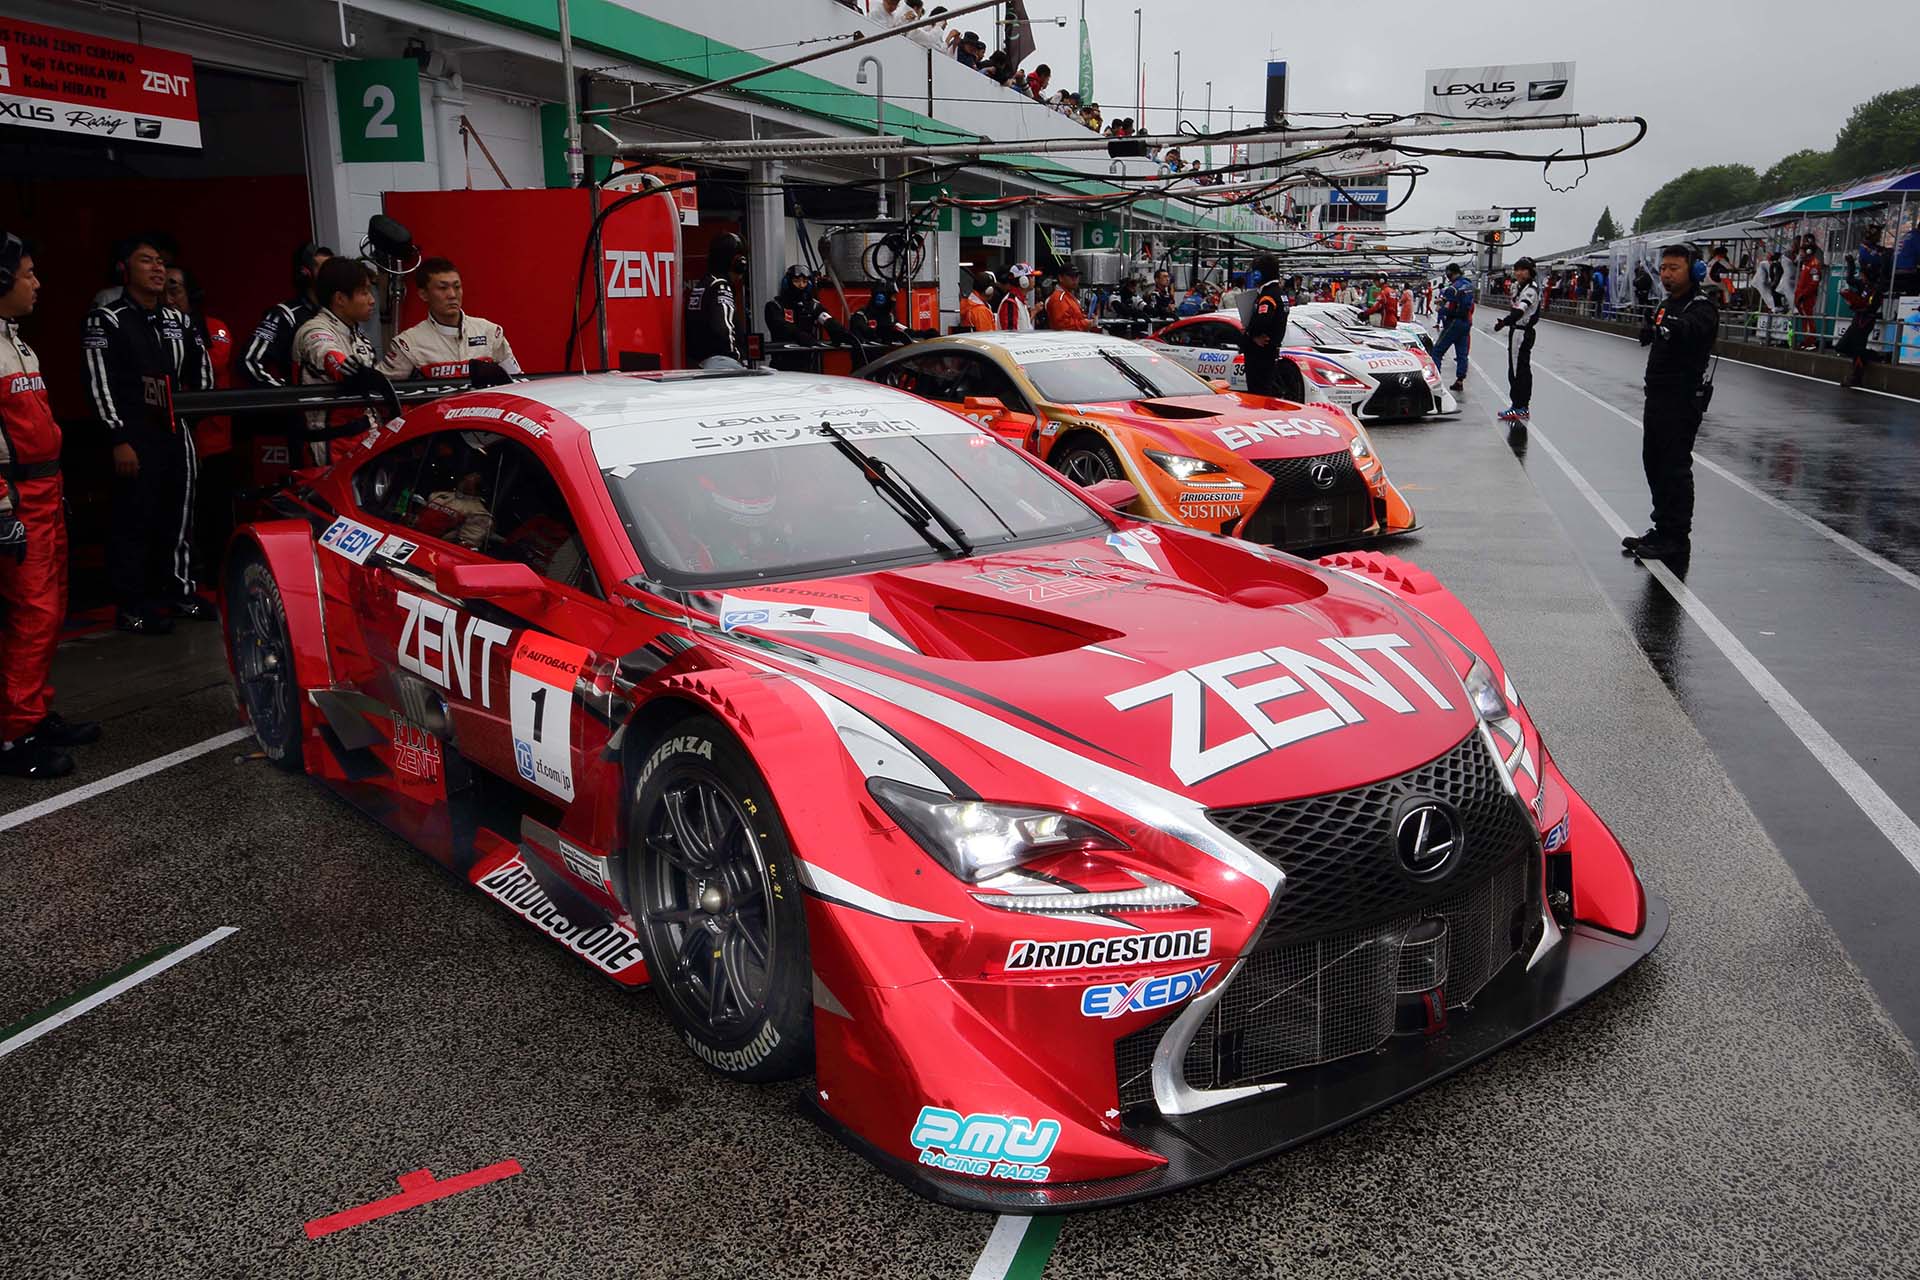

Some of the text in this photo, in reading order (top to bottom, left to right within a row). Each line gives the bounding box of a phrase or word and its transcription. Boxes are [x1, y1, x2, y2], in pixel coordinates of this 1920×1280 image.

[14, 31, 49, 49] TEAM
[52, 38, 82, 56] ZENT
[86, 44, 135, 65] CERUMO
[49, 59, 127, 83] TACHIKAWA
[140, 68, 190, 97] ZENT
[62, 80, 107, 100] HIRATE
[1432, 81, 1515, 96] LEXUS
[64, 110, 128, 135] Racing
[362, 84, 399, 139] 2
[1091, 228, 1104, 245] 6
[605, 250, 675, 298] ZENT
[1197, 364, 1227, 375] DENSO
[1233, 364, 1246, 376] 39
[1368, 357, 1415, 370] DENSO
[697, 413, 801, 429] LEXUS
[1212, 418, 1341, 451] ENEOS
[1179, 492, 1243, 503] BRIDGESTONE
[1179, 504, 1241, 519] SUSTINA
[322, 521, 379, 557] EXEDY
[755, 586, 864, 602] AUTOBACS
[396, 590, 513, 709] ZENT
[526, 650, 579, 675] AUTOBACS
[530, 687, 547, 744] 1
[1103, 632, 1455, 787] ZENT
[393, 742, 441, 778] ZENT
[636, 735, 713, 801] POTENZA
[1007, 929, 1211, 969] BRIDGESTONE
[1081, 963, 1221, 1019] EXEDY
[684, 1018, 781, 1072] BRIDGESTONE
[920, 1152, 1050, 1180] RACING PADS
